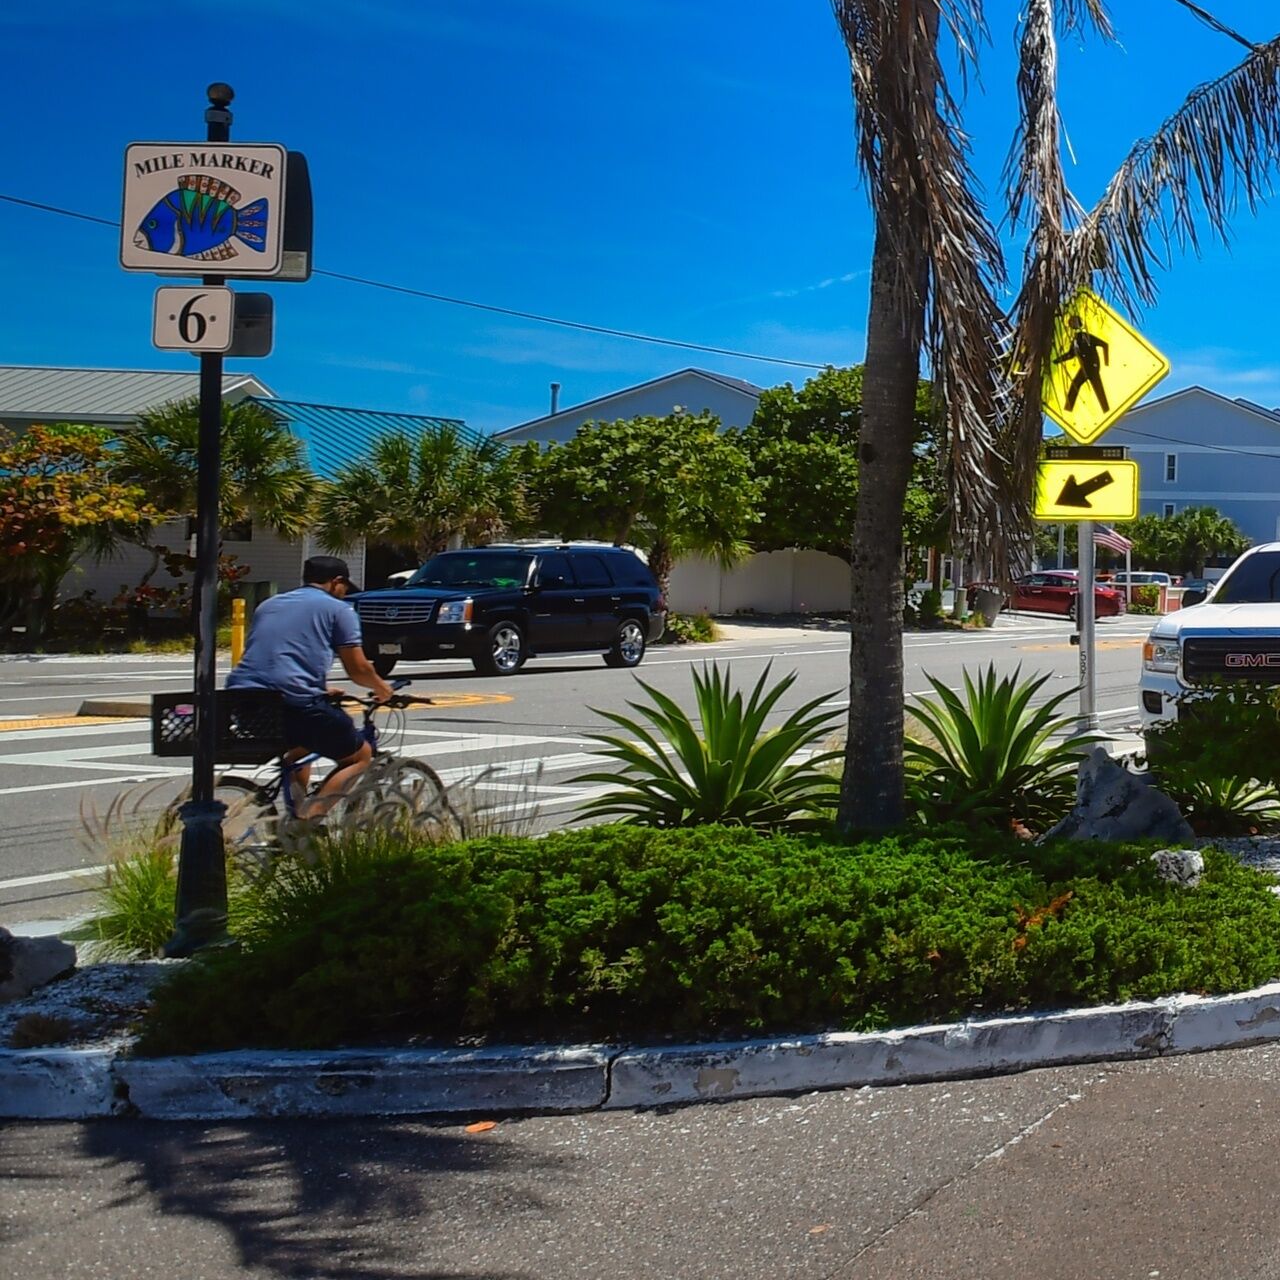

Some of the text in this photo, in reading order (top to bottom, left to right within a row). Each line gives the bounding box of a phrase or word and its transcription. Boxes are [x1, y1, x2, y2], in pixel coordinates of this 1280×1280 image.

[134, 152, 274, 180] MILE MARKER
[178, 293, 208, 343] 6
